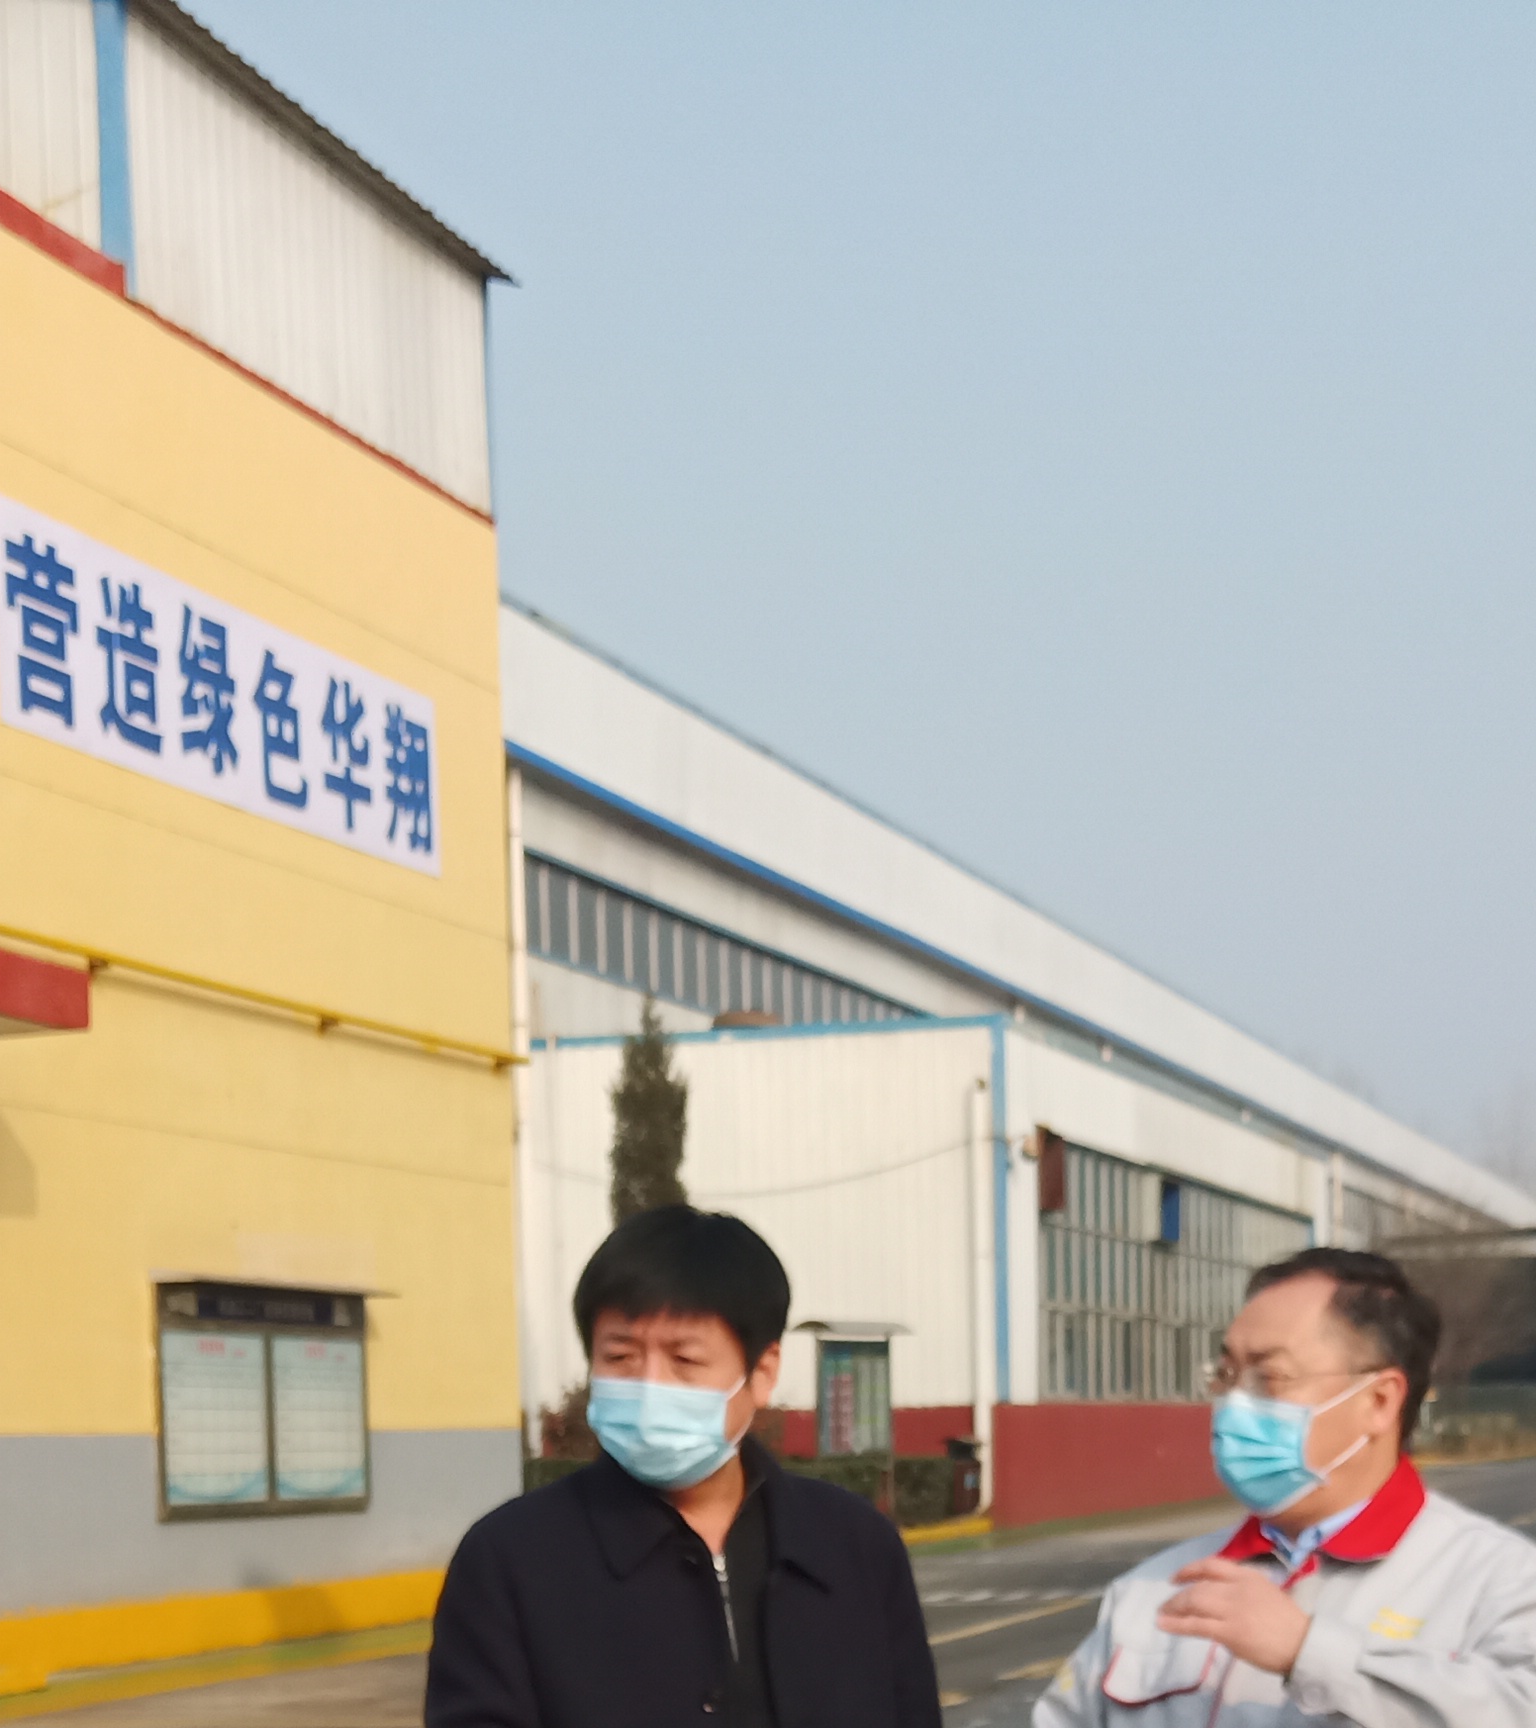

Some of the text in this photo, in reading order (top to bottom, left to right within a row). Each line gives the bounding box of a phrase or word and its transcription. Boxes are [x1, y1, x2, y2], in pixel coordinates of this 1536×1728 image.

[5, 534, 432, 853] 营造绿色华翔
